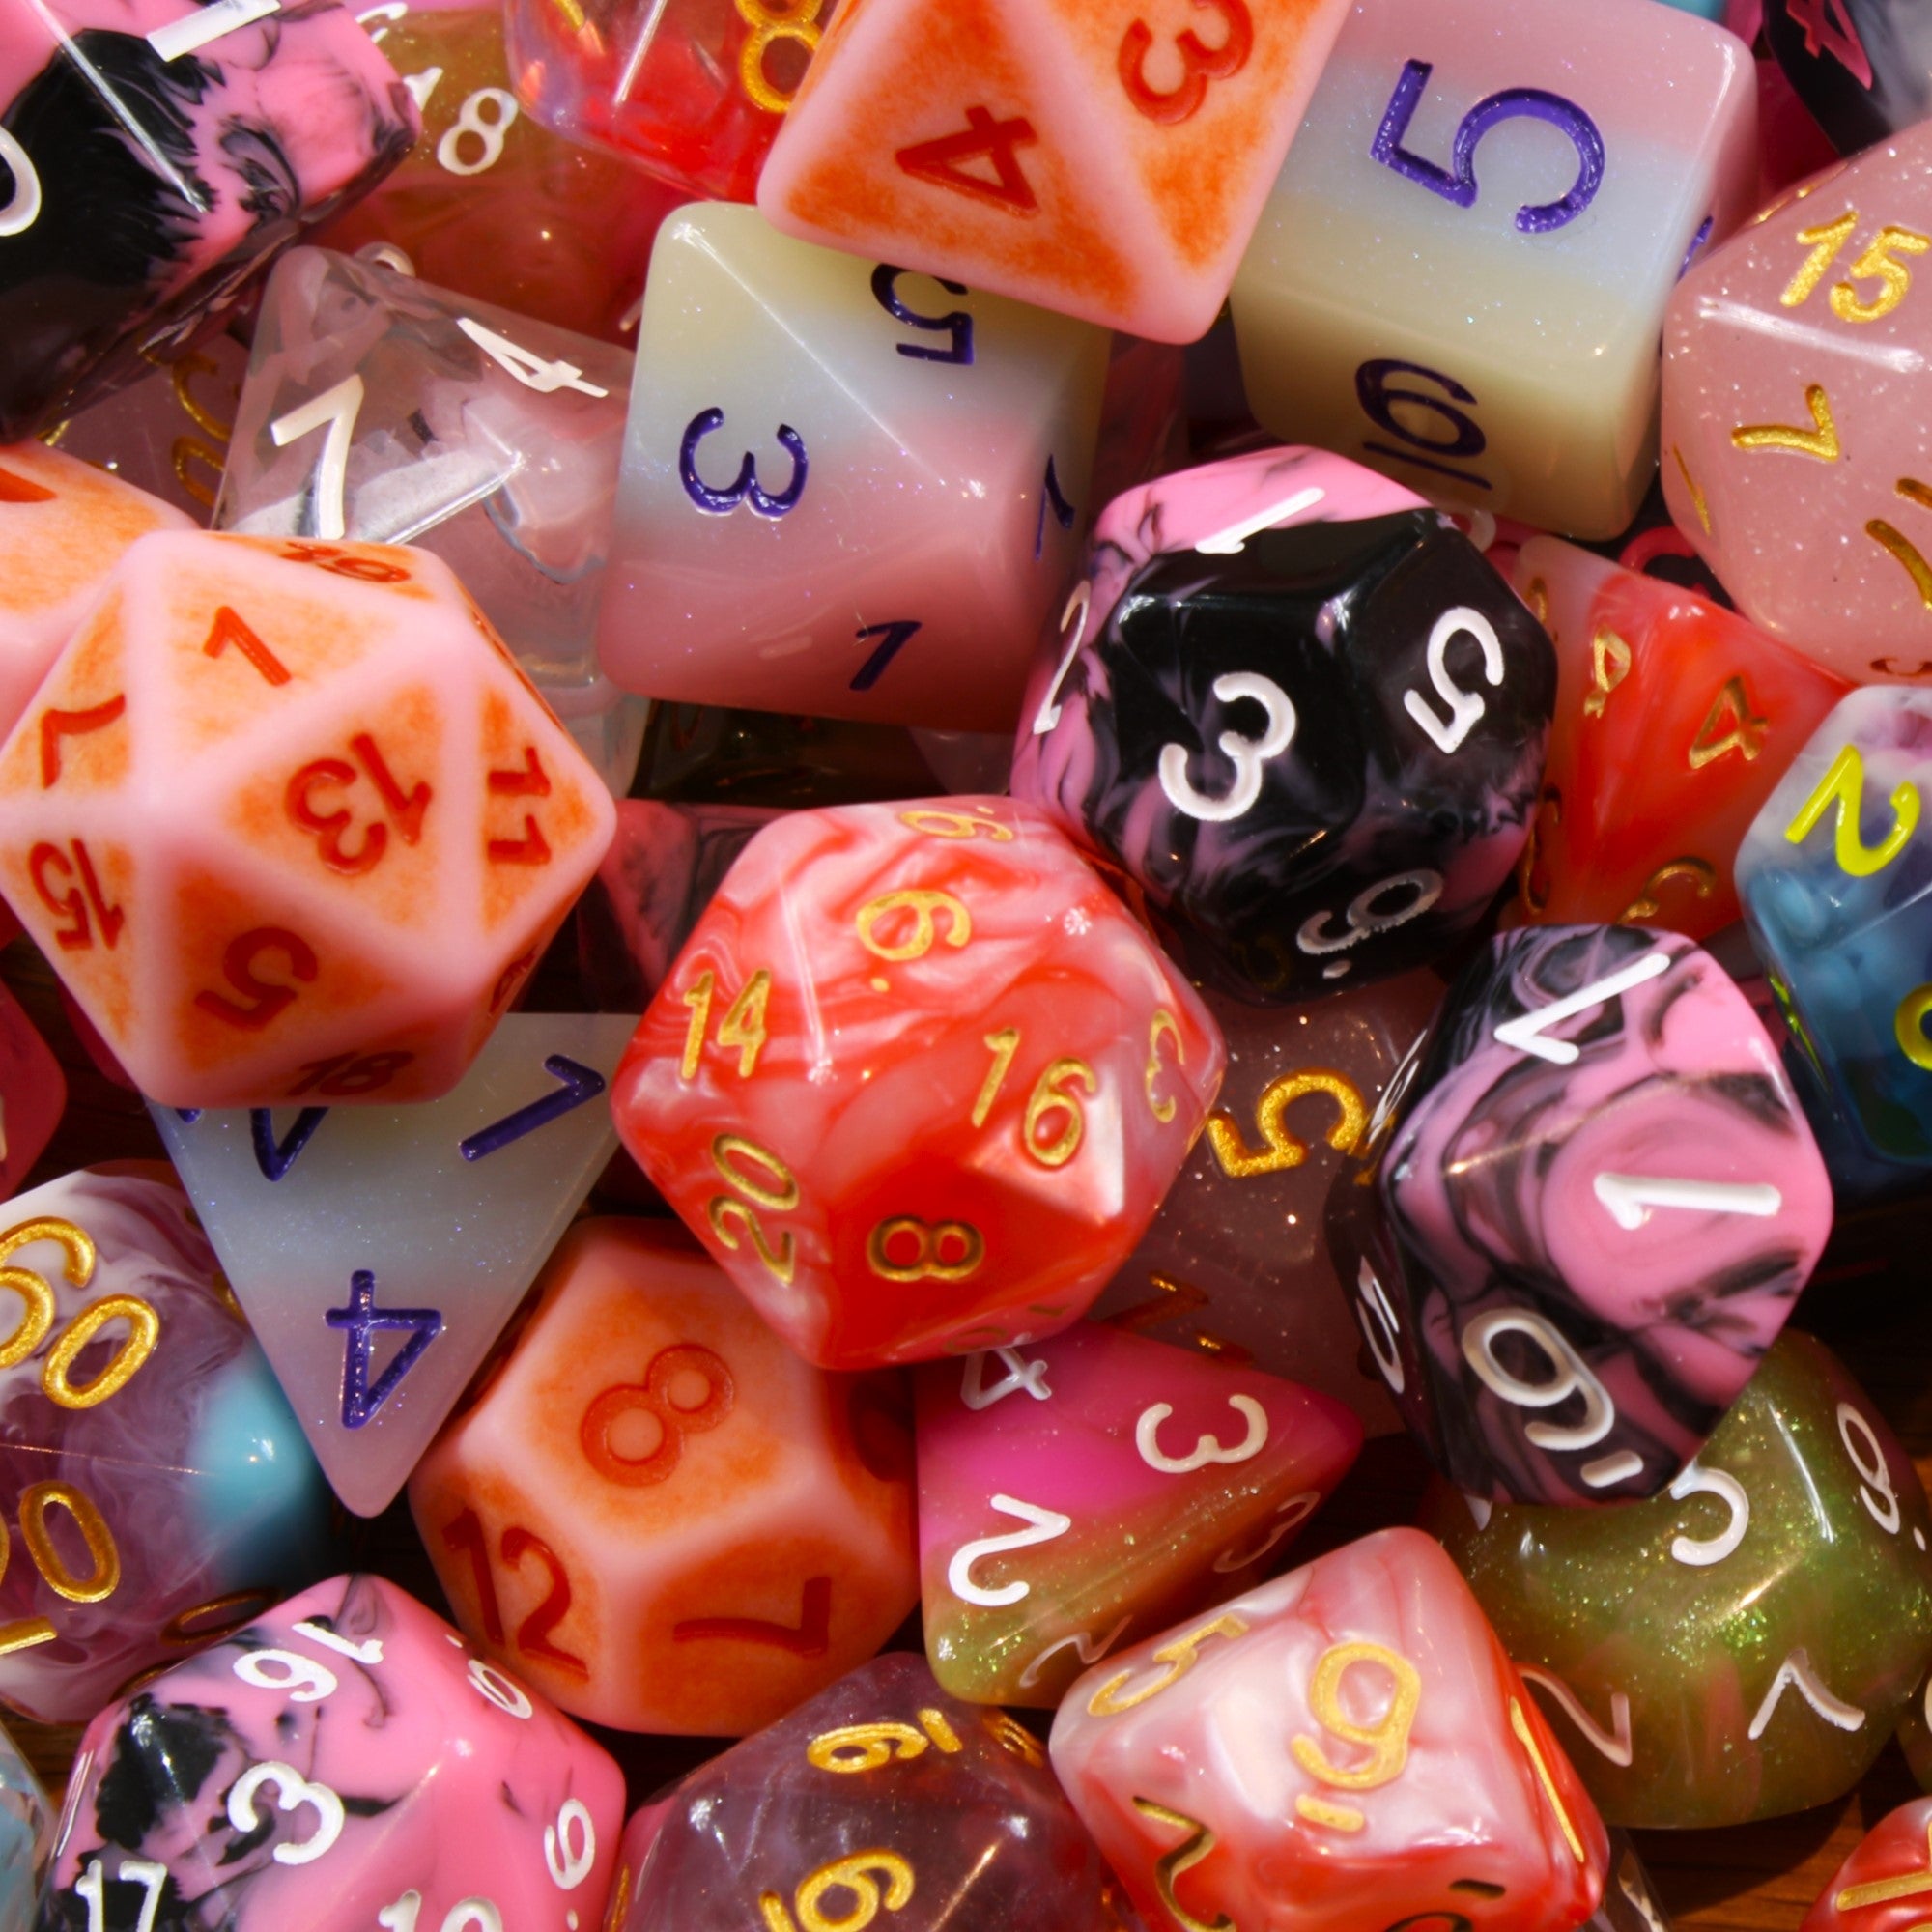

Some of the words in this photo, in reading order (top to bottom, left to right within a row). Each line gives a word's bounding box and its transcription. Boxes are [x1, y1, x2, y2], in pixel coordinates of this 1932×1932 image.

[1119, 0, 1254, 125] 3
[895, 105, 1039, 220] 4
[1372, 58, 1605, 234] 5
[870, 262, 974, 366] 5
[1779, 210, 1931, 323] 15
[456, 317, 609, 394] 4
[270, 373, 364, 540] 7
[678, 406, 809, 521] 3
[1731, 384, 1840, 462] 7
[1194, 487, 1326, 554] 1
[203, 606, 292, 687] 1
[1033, 580, 1092, 735] 2
[1405, 606, 1505, 754] 5
[41, 693, 126, 789] 7
[1157, 671, 1296, 821] 3
[1688, 674, 1770, 771] 4
[284, 732, 433, 875] 13
[486, 746, 553, 866] 11
[1784, 743, 1921, 877] 2
[27, 838, 126, 952] 15
[195, 926, 319, 1032] 5
[681, 969, 772, 1080] 14
[459, 1054, 606, 1162] 1
[970, 1027, 1098, 1169] 16
[1209, 1070, 1366, 1178] 5
[708, 1131, 800, 1287] 20
[867, 1213, 986, 1284] 8
[1593, 1172, 1782, 1230] 1
[325, 1268, 442, 1430] 4
[580, 1341, 736, 1489] 8
[1136, 1393, 1269, 1474] 3
[440, 1505, 591, 1685] 12
[948, 1492, 1072, 1608] 2
[233, 1621, 384, 1703] 16
[1087, 1612, 1251, 1718] 5
[1747, 1648, 1867, 1741] 7
[228, 1760, 345, 1866] 3
[75, 1859, 169, 1932] 17
